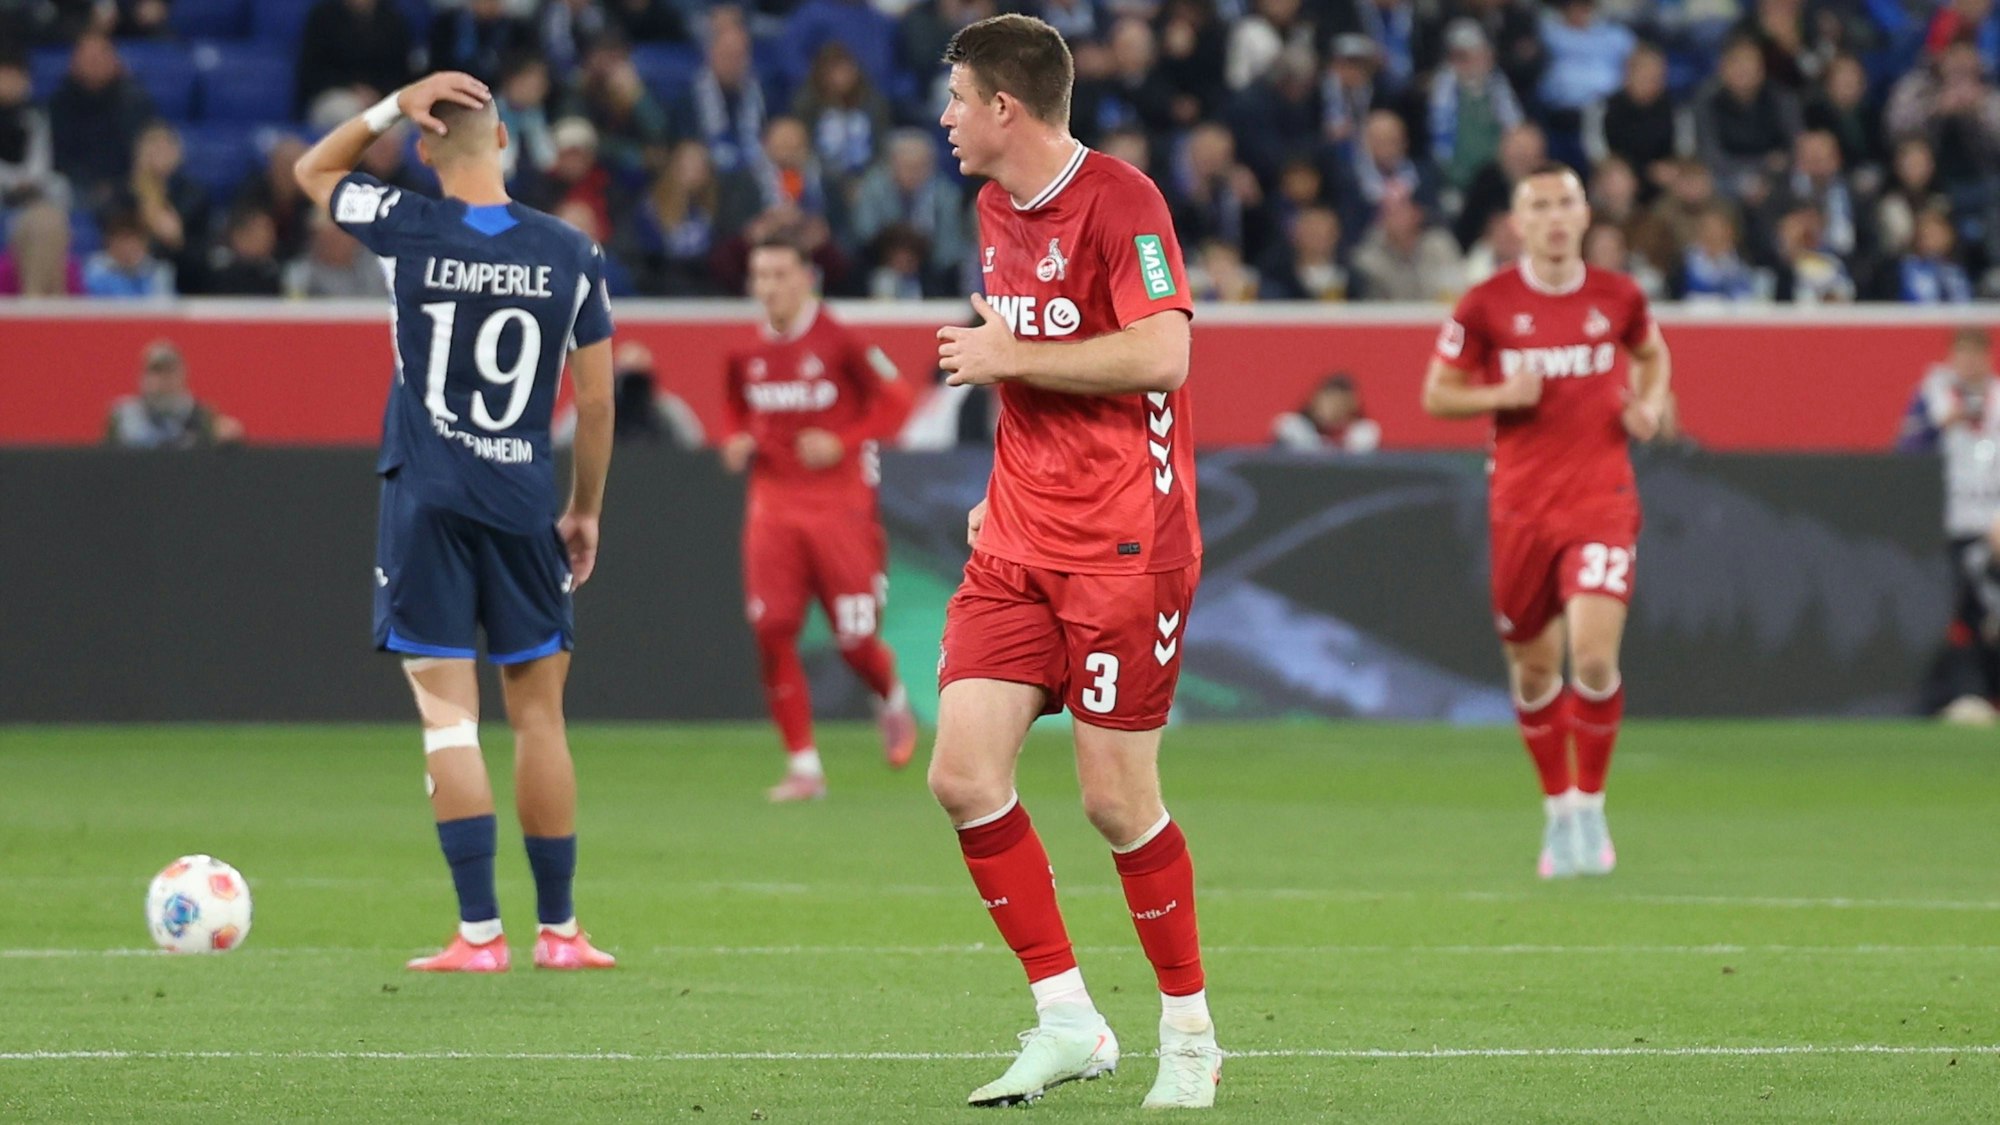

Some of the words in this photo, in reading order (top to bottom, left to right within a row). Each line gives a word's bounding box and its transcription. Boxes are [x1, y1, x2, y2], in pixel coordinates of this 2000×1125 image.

[424, 256, 552, 298] LEMPERLE
[1141, 240, 1170, 294] DEVK
[420, 301, 542, 432] 19
[1577, 541, 1629, 595] 32
[1081, 651, 1120, 714] 3
